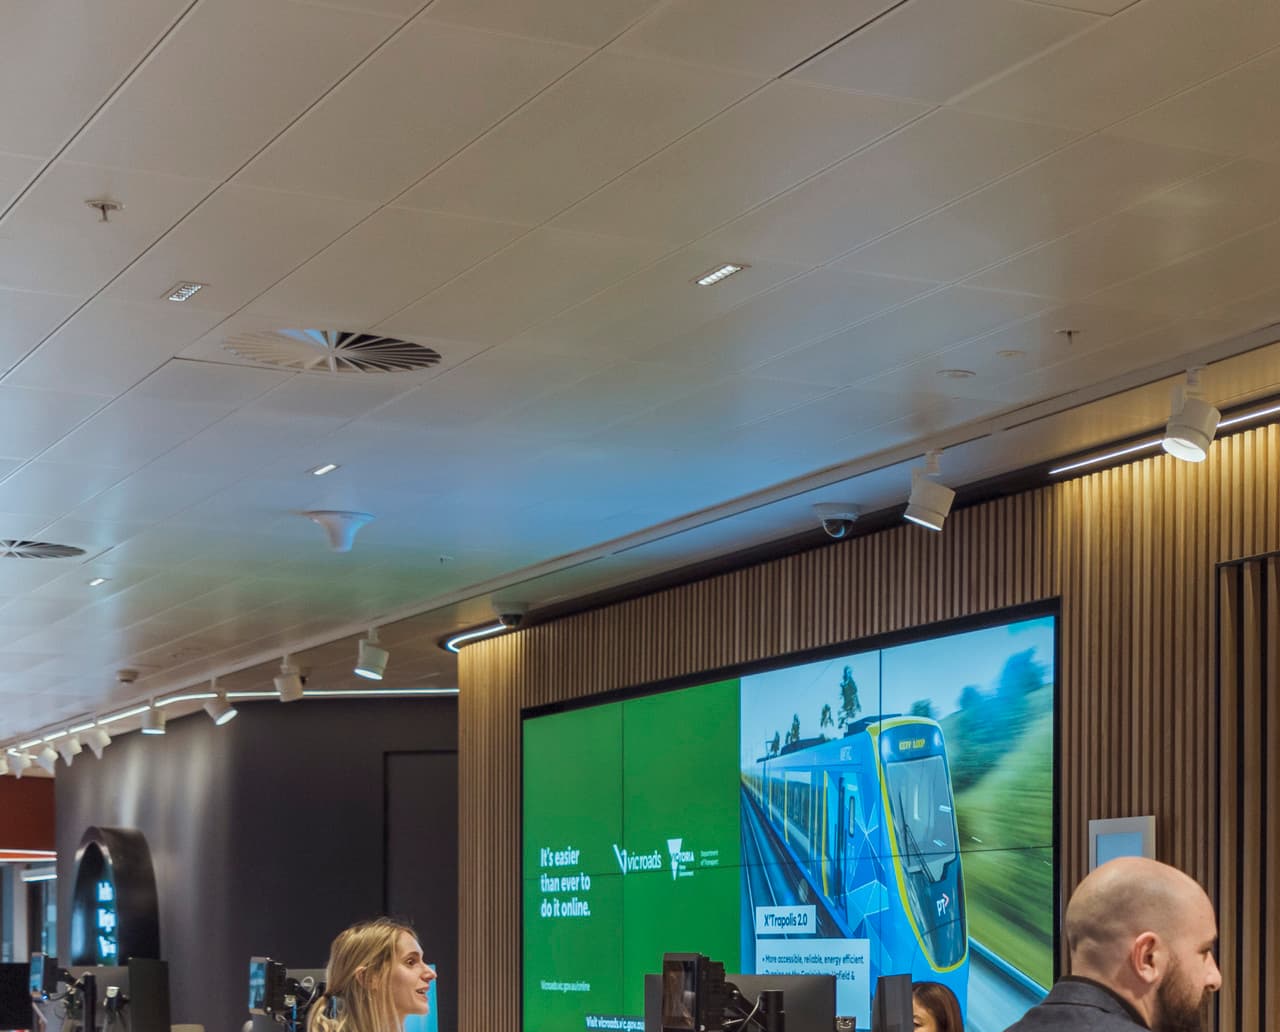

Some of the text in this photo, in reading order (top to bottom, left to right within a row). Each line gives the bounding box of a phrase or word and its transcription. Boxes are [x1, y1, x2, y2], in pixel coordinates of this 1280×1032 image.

[541, 846, 580, 867] It's easier
[628, 850, 662, 870] vicroads
[541, 872, 591, 893] than ever to
[541, 897, 591, 917] do it online.
[798, 913, 808, 926] 2.0
